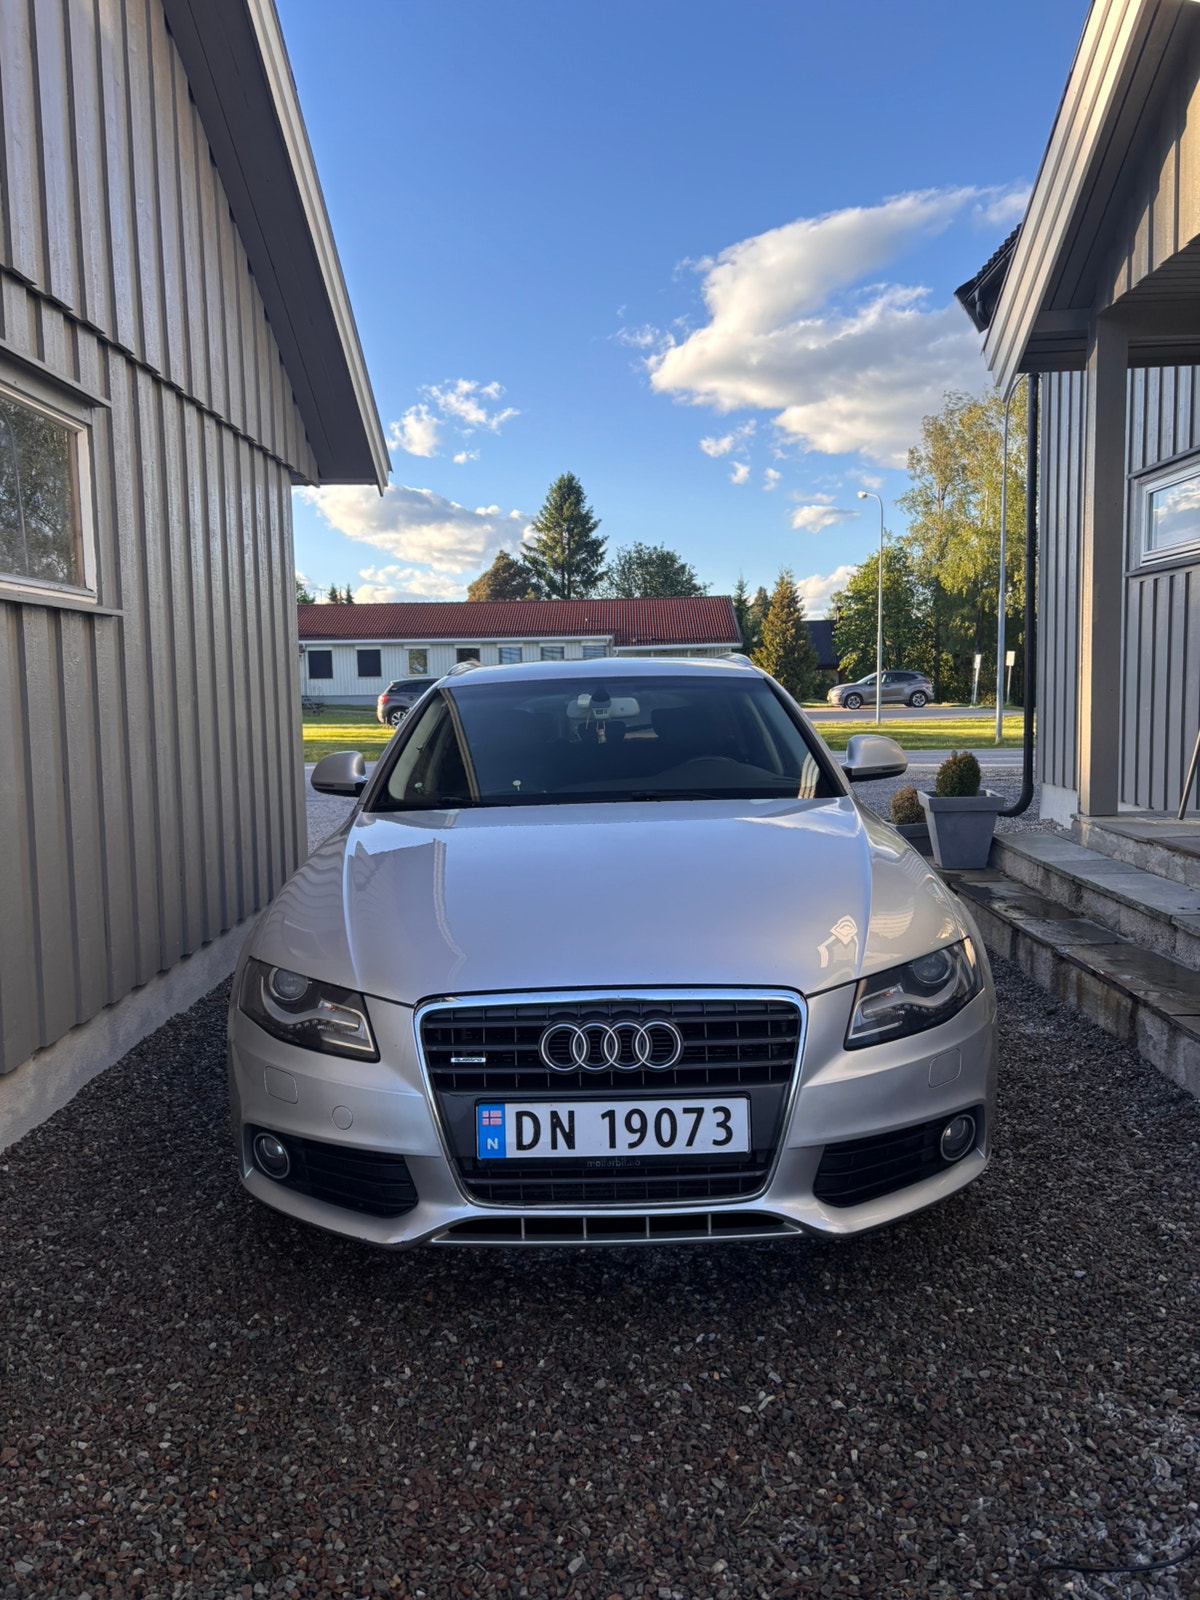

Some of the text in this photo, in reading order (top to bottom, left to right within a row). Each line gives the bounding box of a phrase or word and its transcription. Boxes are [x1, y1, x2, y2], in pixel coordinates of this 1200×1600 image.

[515, 1106, 733, 1151] DN 19073
[487, 1138, 499, 1150] N
